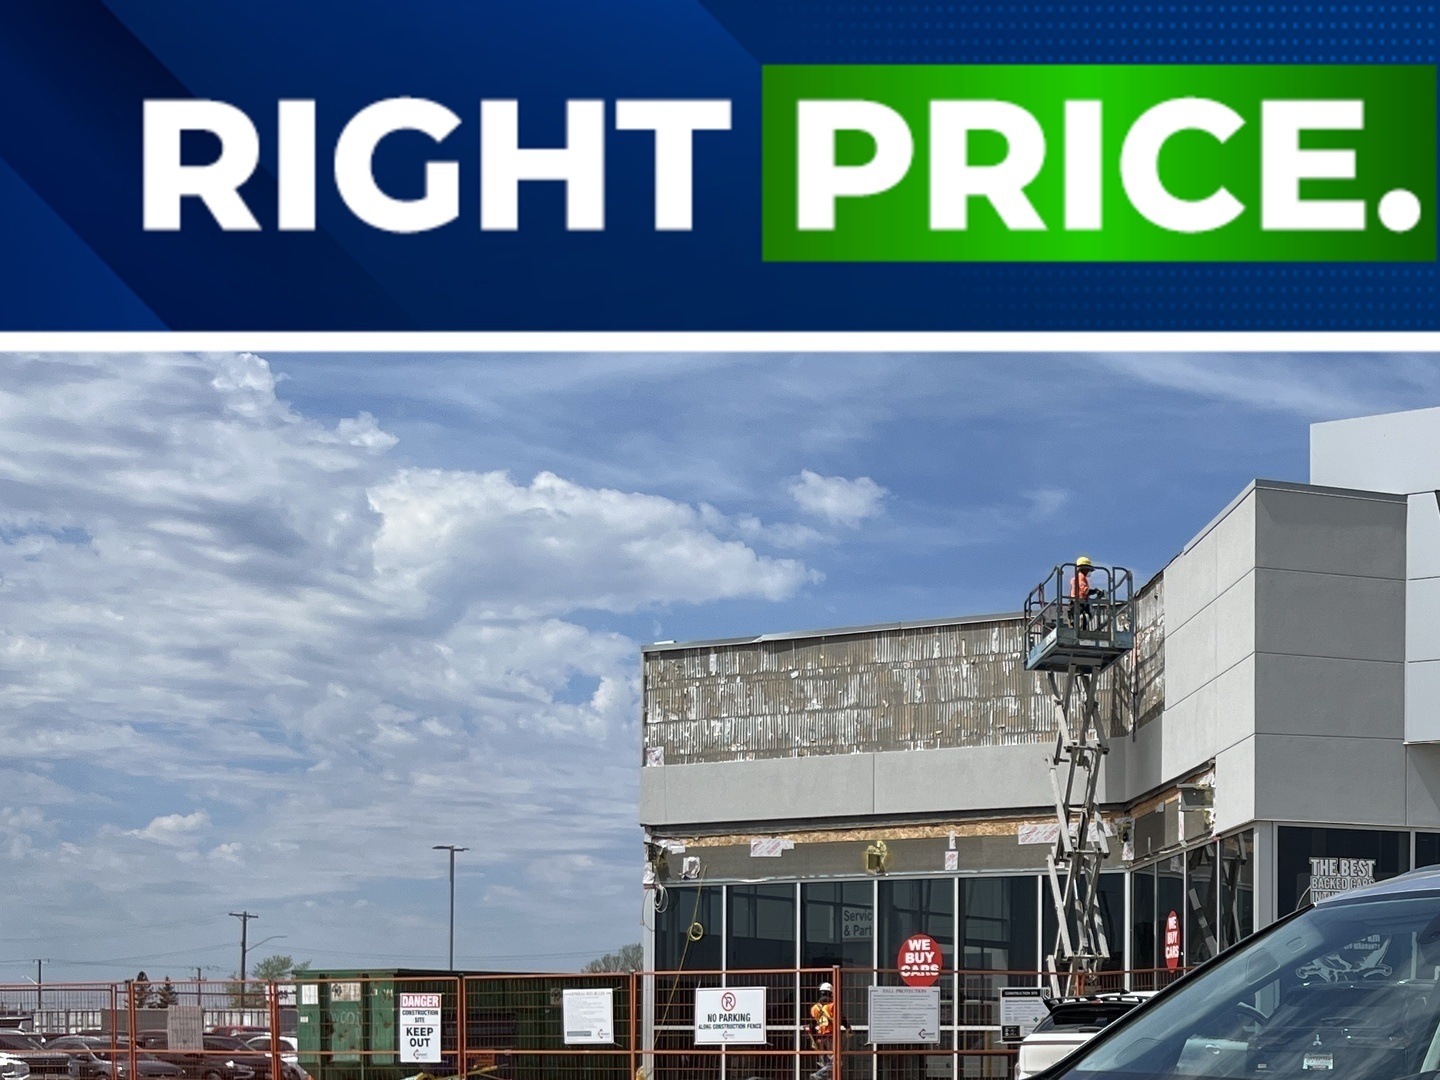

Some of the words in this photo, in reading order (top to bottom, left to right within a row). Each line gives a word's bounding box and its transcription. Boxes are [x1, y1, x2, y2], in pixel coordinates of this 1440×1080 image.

[1309, 858, 1337, 876] THE
[1341, 858, 1376, 877] BEST
[1311, 877, 1348, 890] BACKED
[843, 909, 873, 922] Servic
[1168, 916, 1177, 930] WE
[843, 925, 851, 937] &
[853, 925, 872, 937] Part
[1167, 931, 1178, 944] BUY
[908, 939, 931, 951] WE
[905, 952, 935, 964] BUY
[1165, 945, 1180, 959] CARS
[900, 964, 939, 977] CARS
[402, 995, 439, 1007] DANGER
[707, 1013, 717, 1022] NO
[719, 1013, 751, 1022] PARKING
[406, 1027, 434, 1037] KEEP
[409, 1038, 431, 1047] OUT
